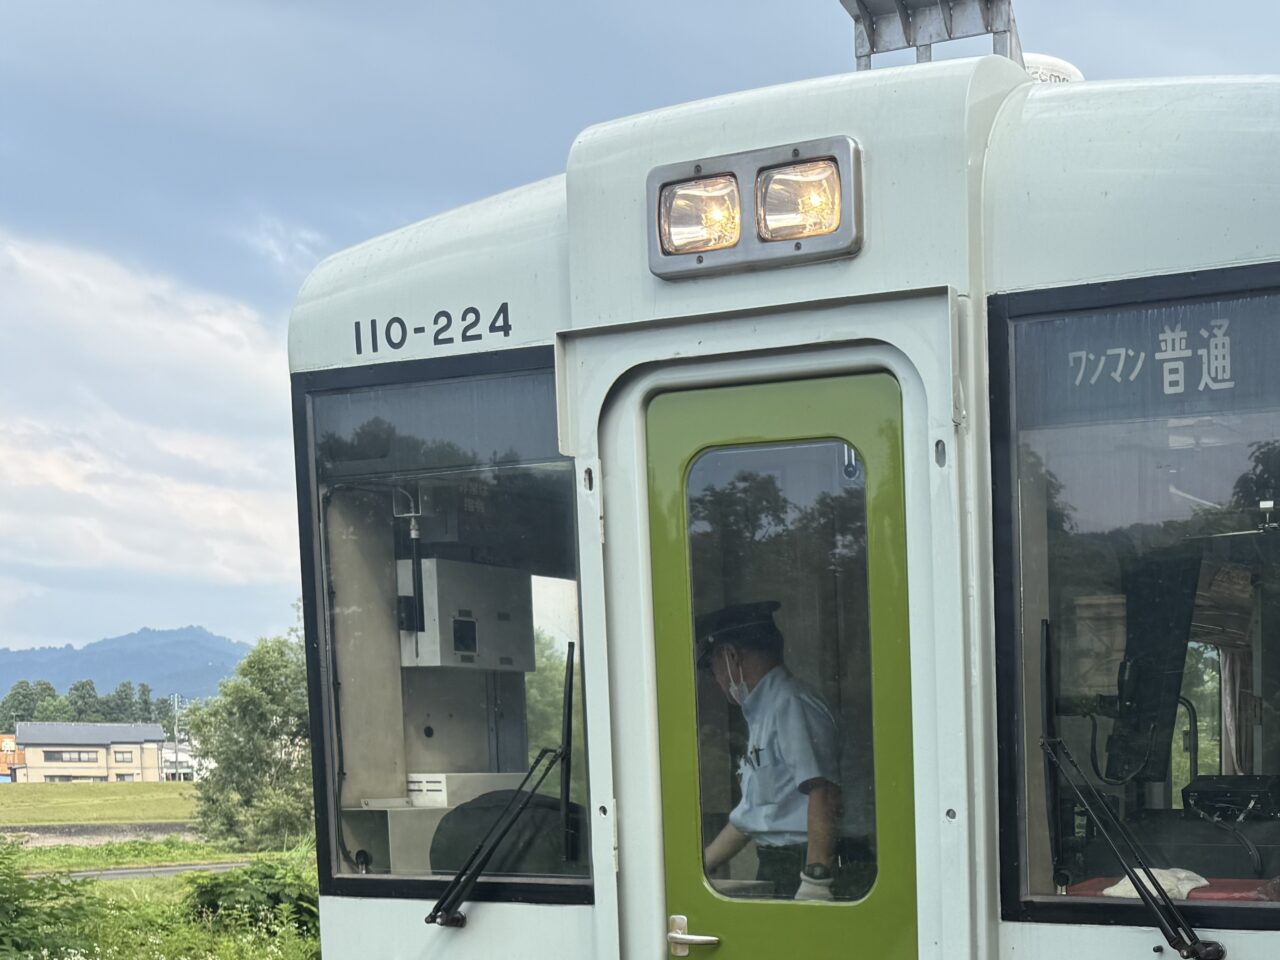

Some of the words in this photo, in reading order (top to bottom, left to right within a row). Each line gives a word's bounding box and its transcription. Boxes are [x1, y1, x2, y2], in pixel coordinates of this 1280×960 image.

[355, 302, 512, 355] 110-224
[1068, 348, 1146, 387] ワンマン
[1155, 318, 1235, 395] 普通
